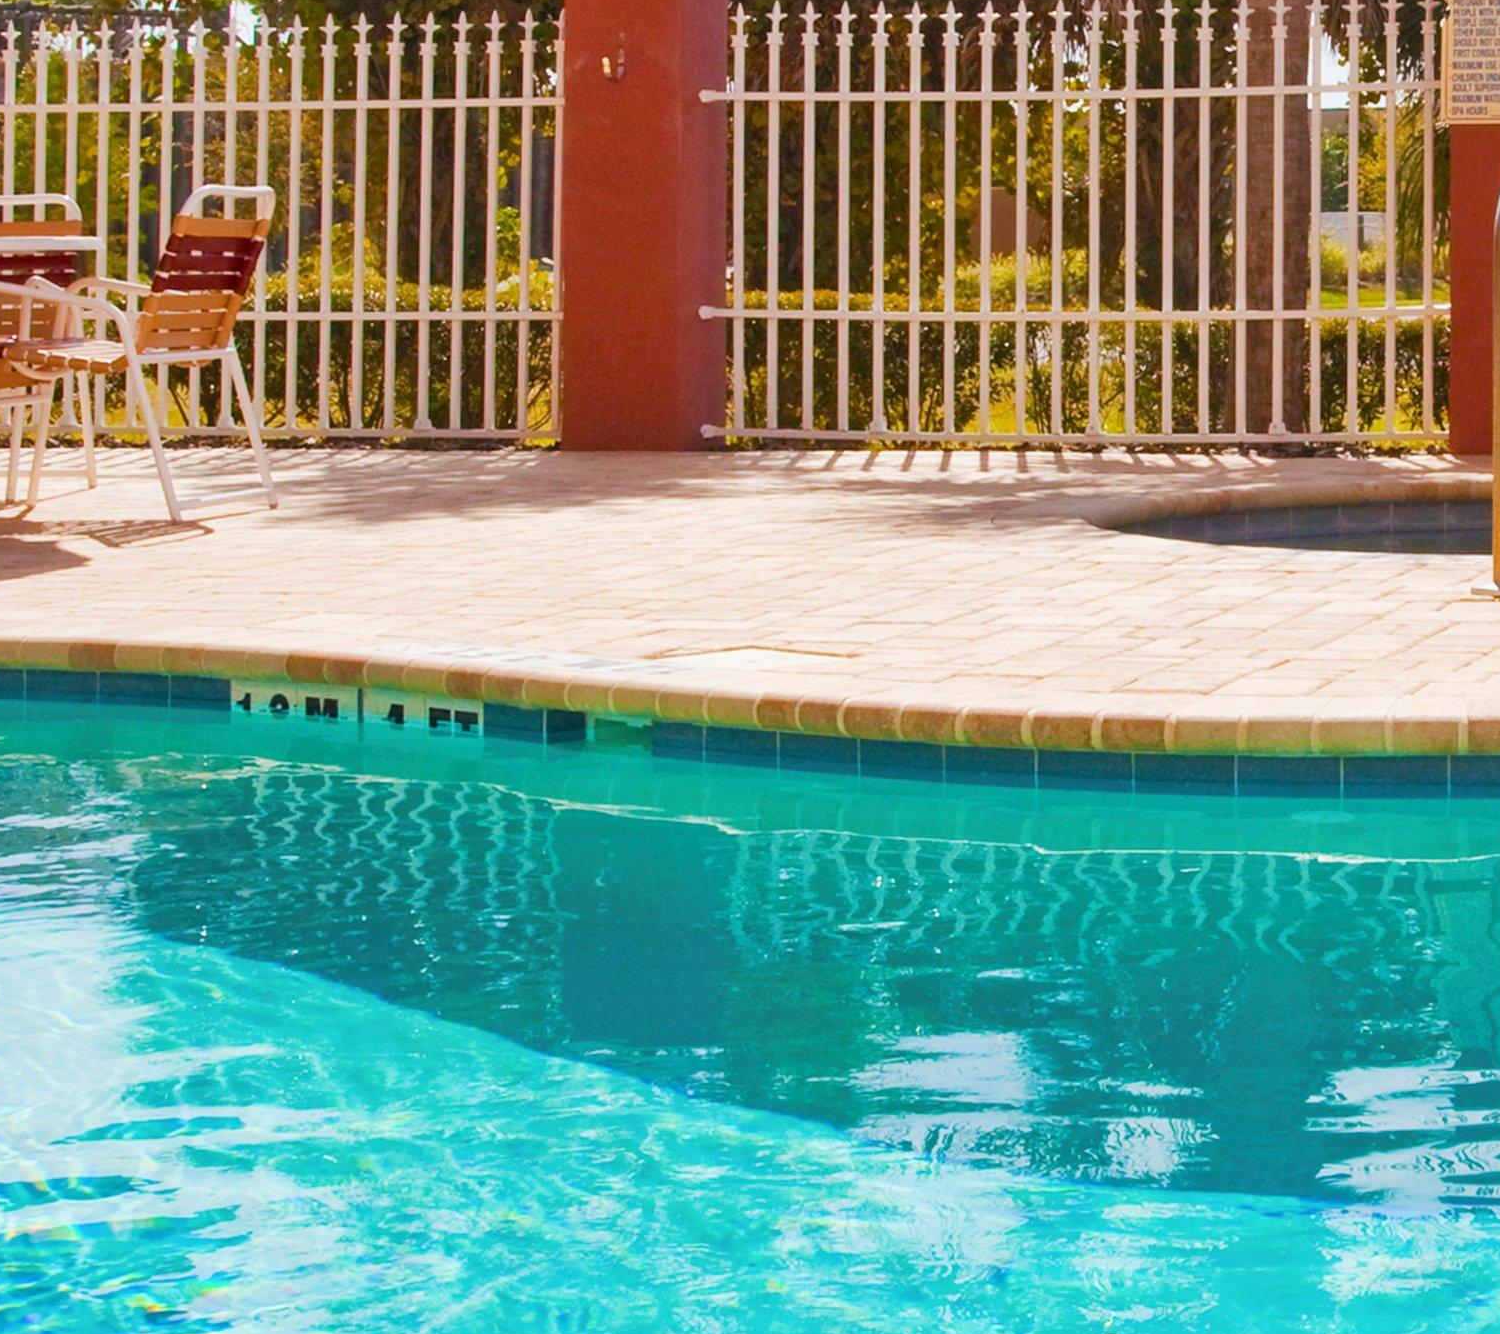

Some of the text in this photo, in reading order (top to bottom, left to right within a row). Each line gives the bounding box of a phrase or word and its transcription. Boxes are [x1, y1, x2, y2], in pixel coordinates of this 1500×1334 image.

[1479, 8, 1493, 16] WITH
[1480, 38, 1492, 46] NOT
[1453, 49, 1470, 57] FIRST
[1452, 107, 1464, 115] SPA
